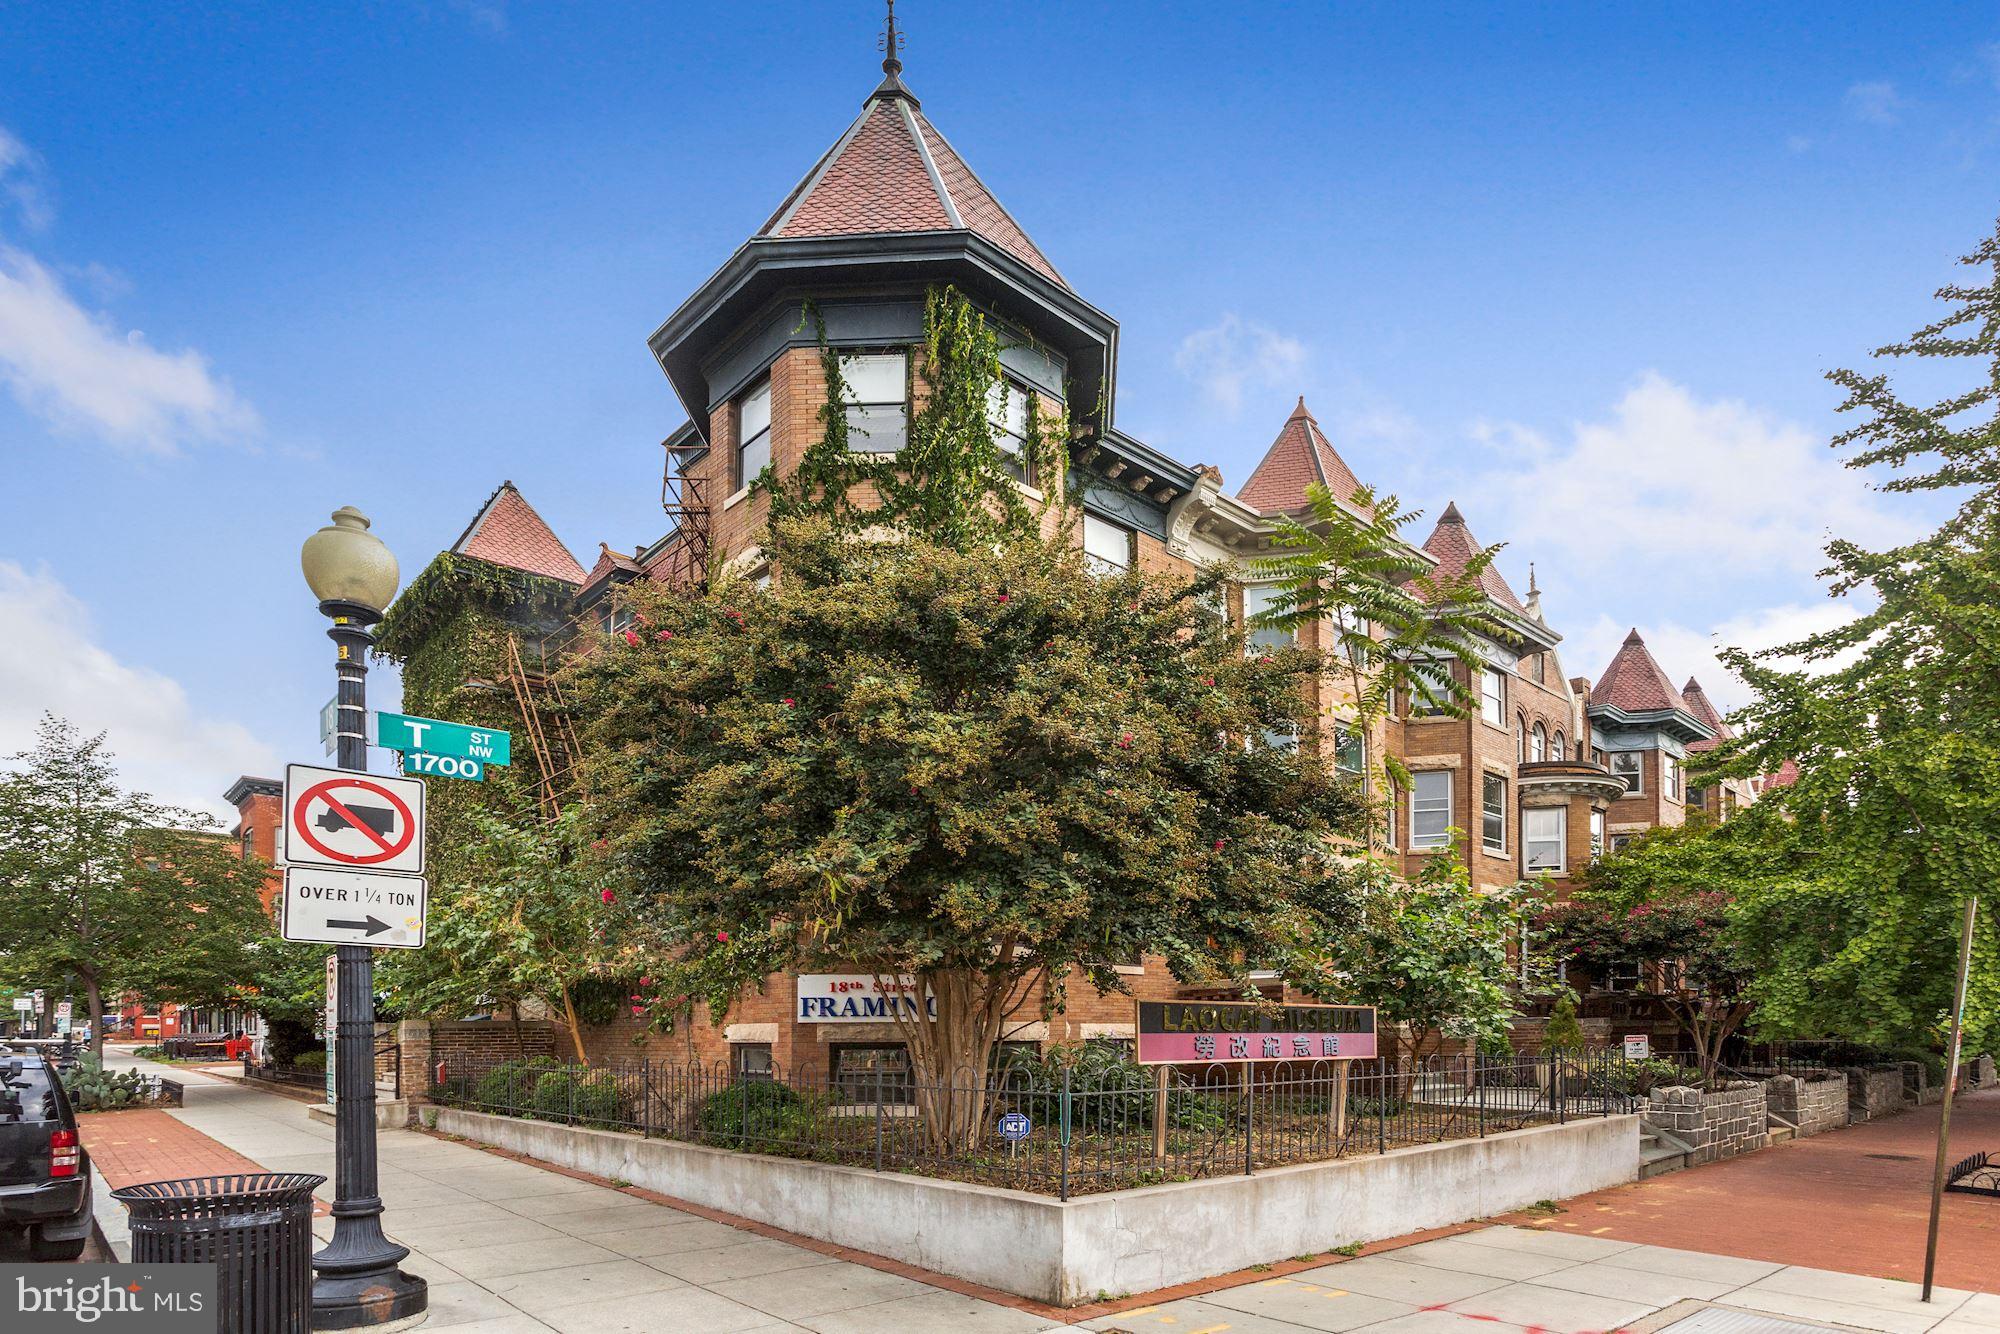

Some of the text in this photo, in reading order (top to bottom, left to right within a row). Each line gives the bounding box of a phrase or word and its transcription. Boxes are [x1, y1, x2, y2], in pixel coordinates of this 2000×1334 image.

[403, 721, 431, 748] T
[470, 732, 492, 744] ST
[469, 745, 493, 758] NW
[409, 753, 479, 778] 1700
[300, 886, 347, 902] OVER
[388, 892, 415, 906] TON
[829, 981, 864, 993] 18th
